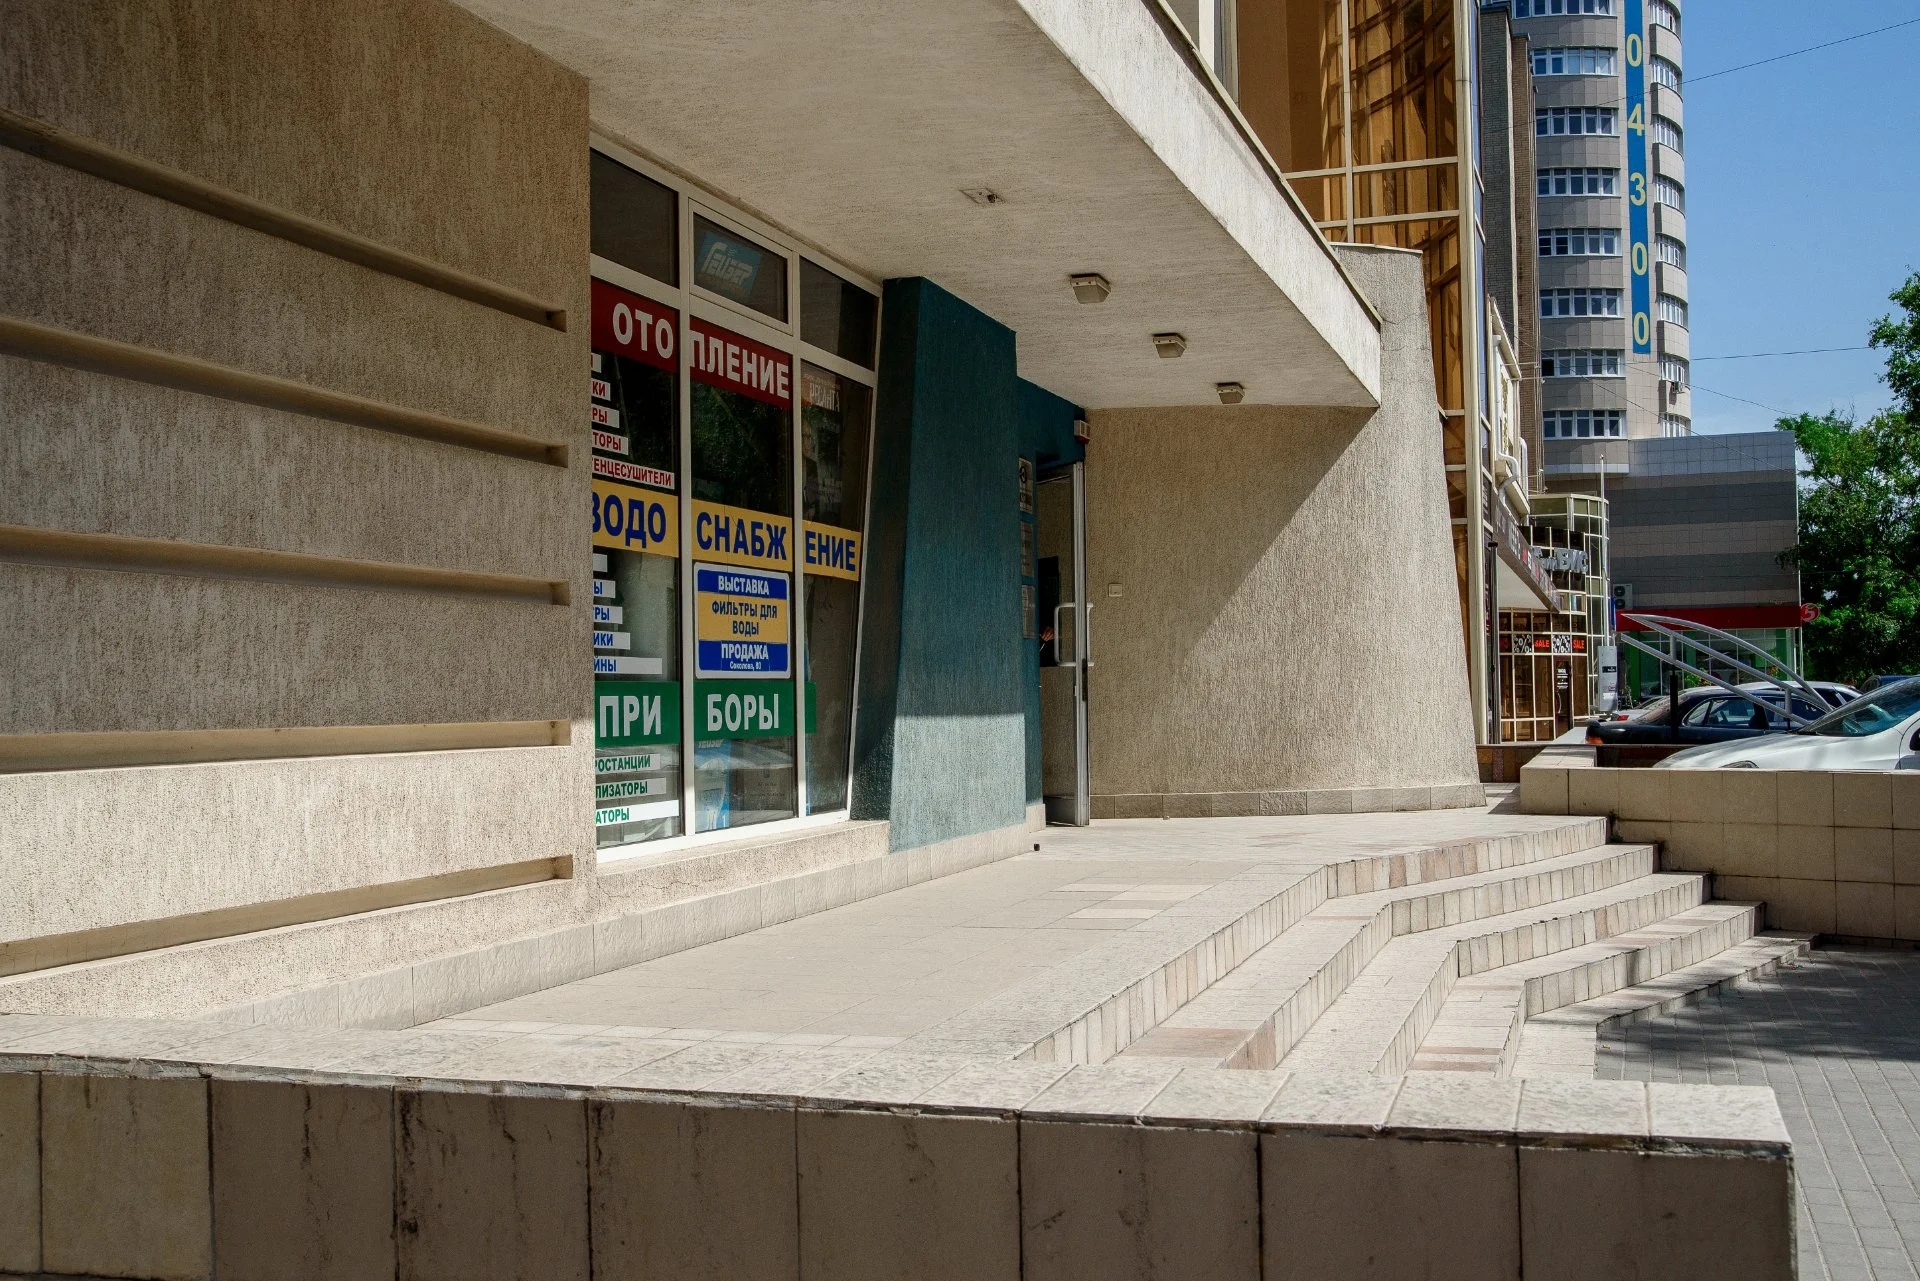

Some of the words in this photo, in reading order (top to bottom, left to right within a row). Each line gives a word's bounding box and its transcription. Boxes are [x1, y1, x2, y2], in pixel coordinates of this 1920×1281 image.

[592, 456, 672, 487] ЕНЦЕСУШИТЕЛИ
[718, 574, 770, 596] ВЫСТАВКА
[593, 606, 610, 621] РЫ
[711, 600, 758, 618] ФИЛЬТРЫ
[759, 604, 778, 621] ДЛЯ
[732, 620, 760, 636] ВОДЫ
[721, 643, 769, 662] ПРОДАЖА
[595, 807, 630, 824] АТОРЫ
